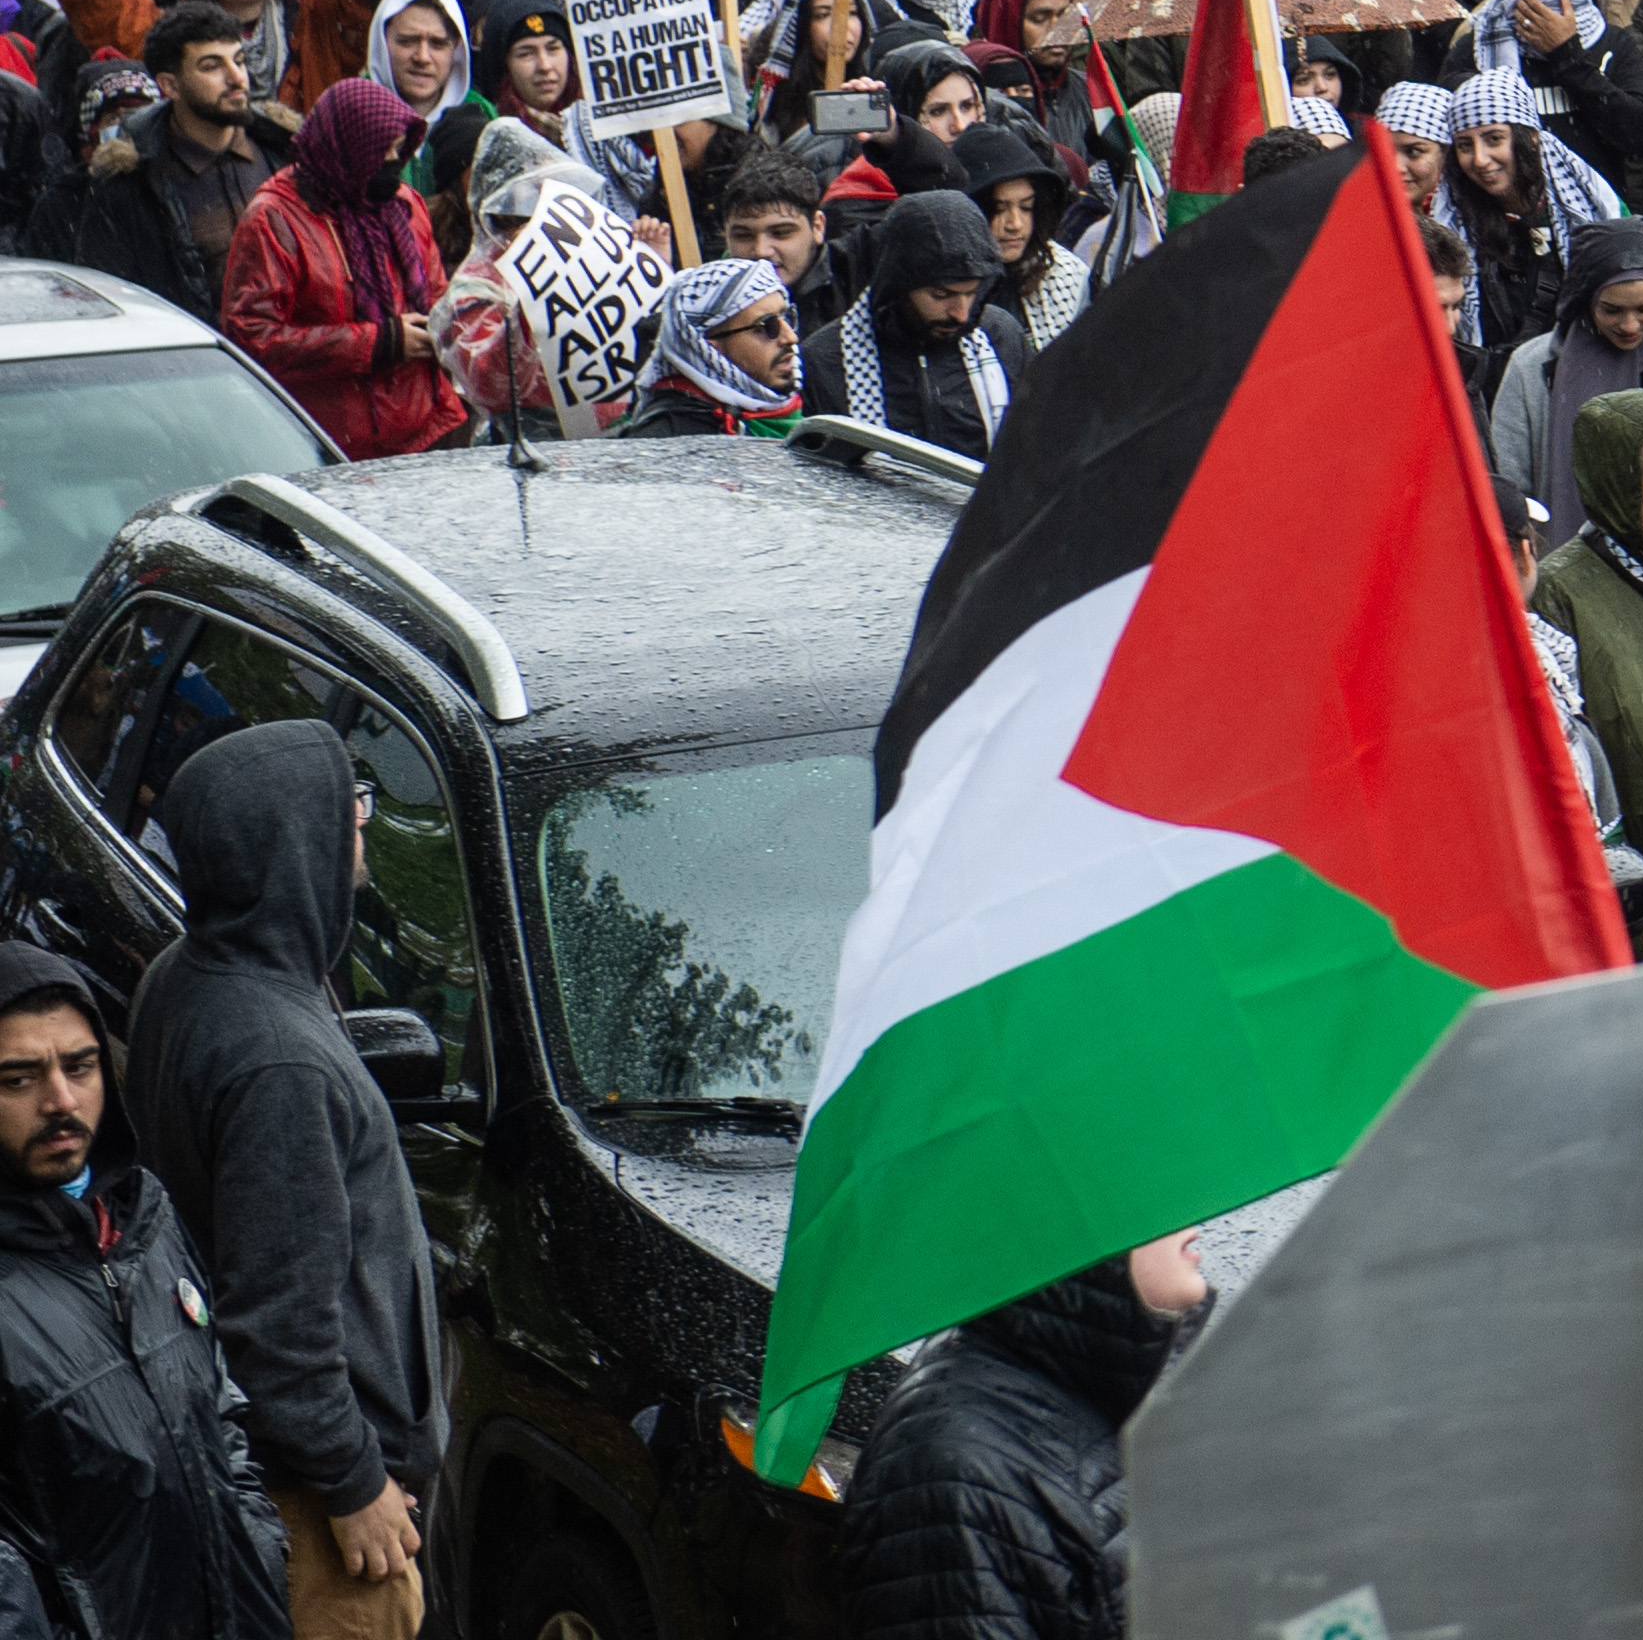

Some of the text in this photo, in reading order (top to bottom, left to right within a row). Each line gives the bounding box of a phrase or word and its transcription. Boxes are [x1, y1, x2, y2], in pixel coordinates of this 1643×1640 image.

[584, 12, 709, 59] IS A HUMAN
[589, 39, 717, 102] RIGHT!
[513, 194, 595, 300] END
[545, 211, 633, 338] ALL US
[558, 252, 663, 374] AID TO
[558, 341, 638, 407] ISR
